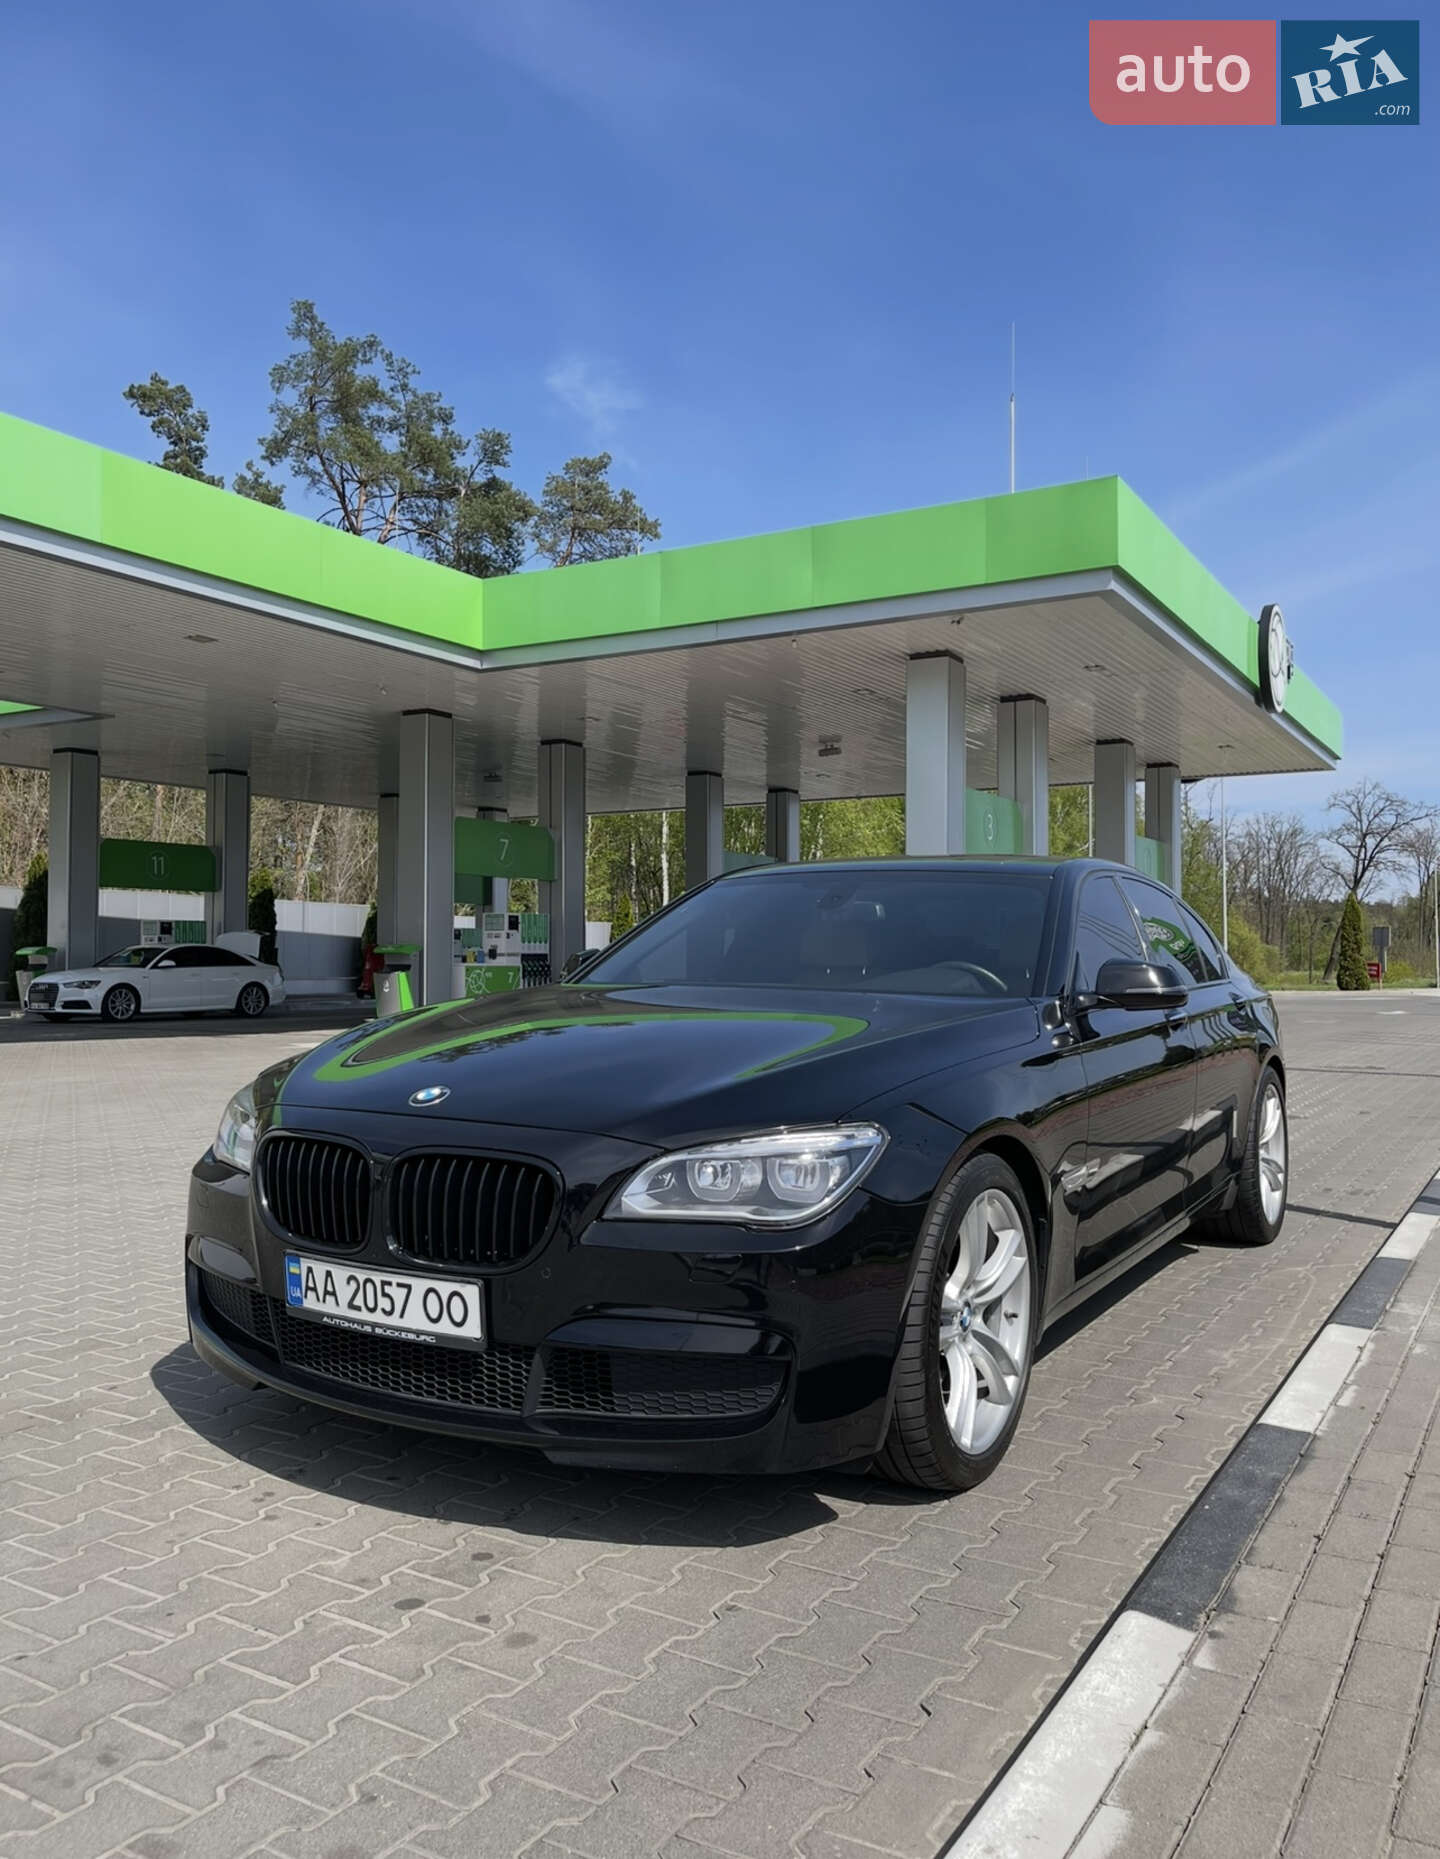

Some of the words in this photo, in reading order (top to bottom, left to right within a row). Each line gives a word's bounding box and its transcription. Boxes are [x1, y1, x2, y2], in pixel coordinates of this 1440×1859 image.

[499, 839, 509, 861] 7
[152, 856, 165, 875] 11
[507, 971, 514, 983] 7
[290, 1286, 301, 1297] UA
[304, 1265, 340, 1307] AA
[346, 1274, 412, 1319] 2057
[322, 1316, 372, 1333] AUTOHAUS
